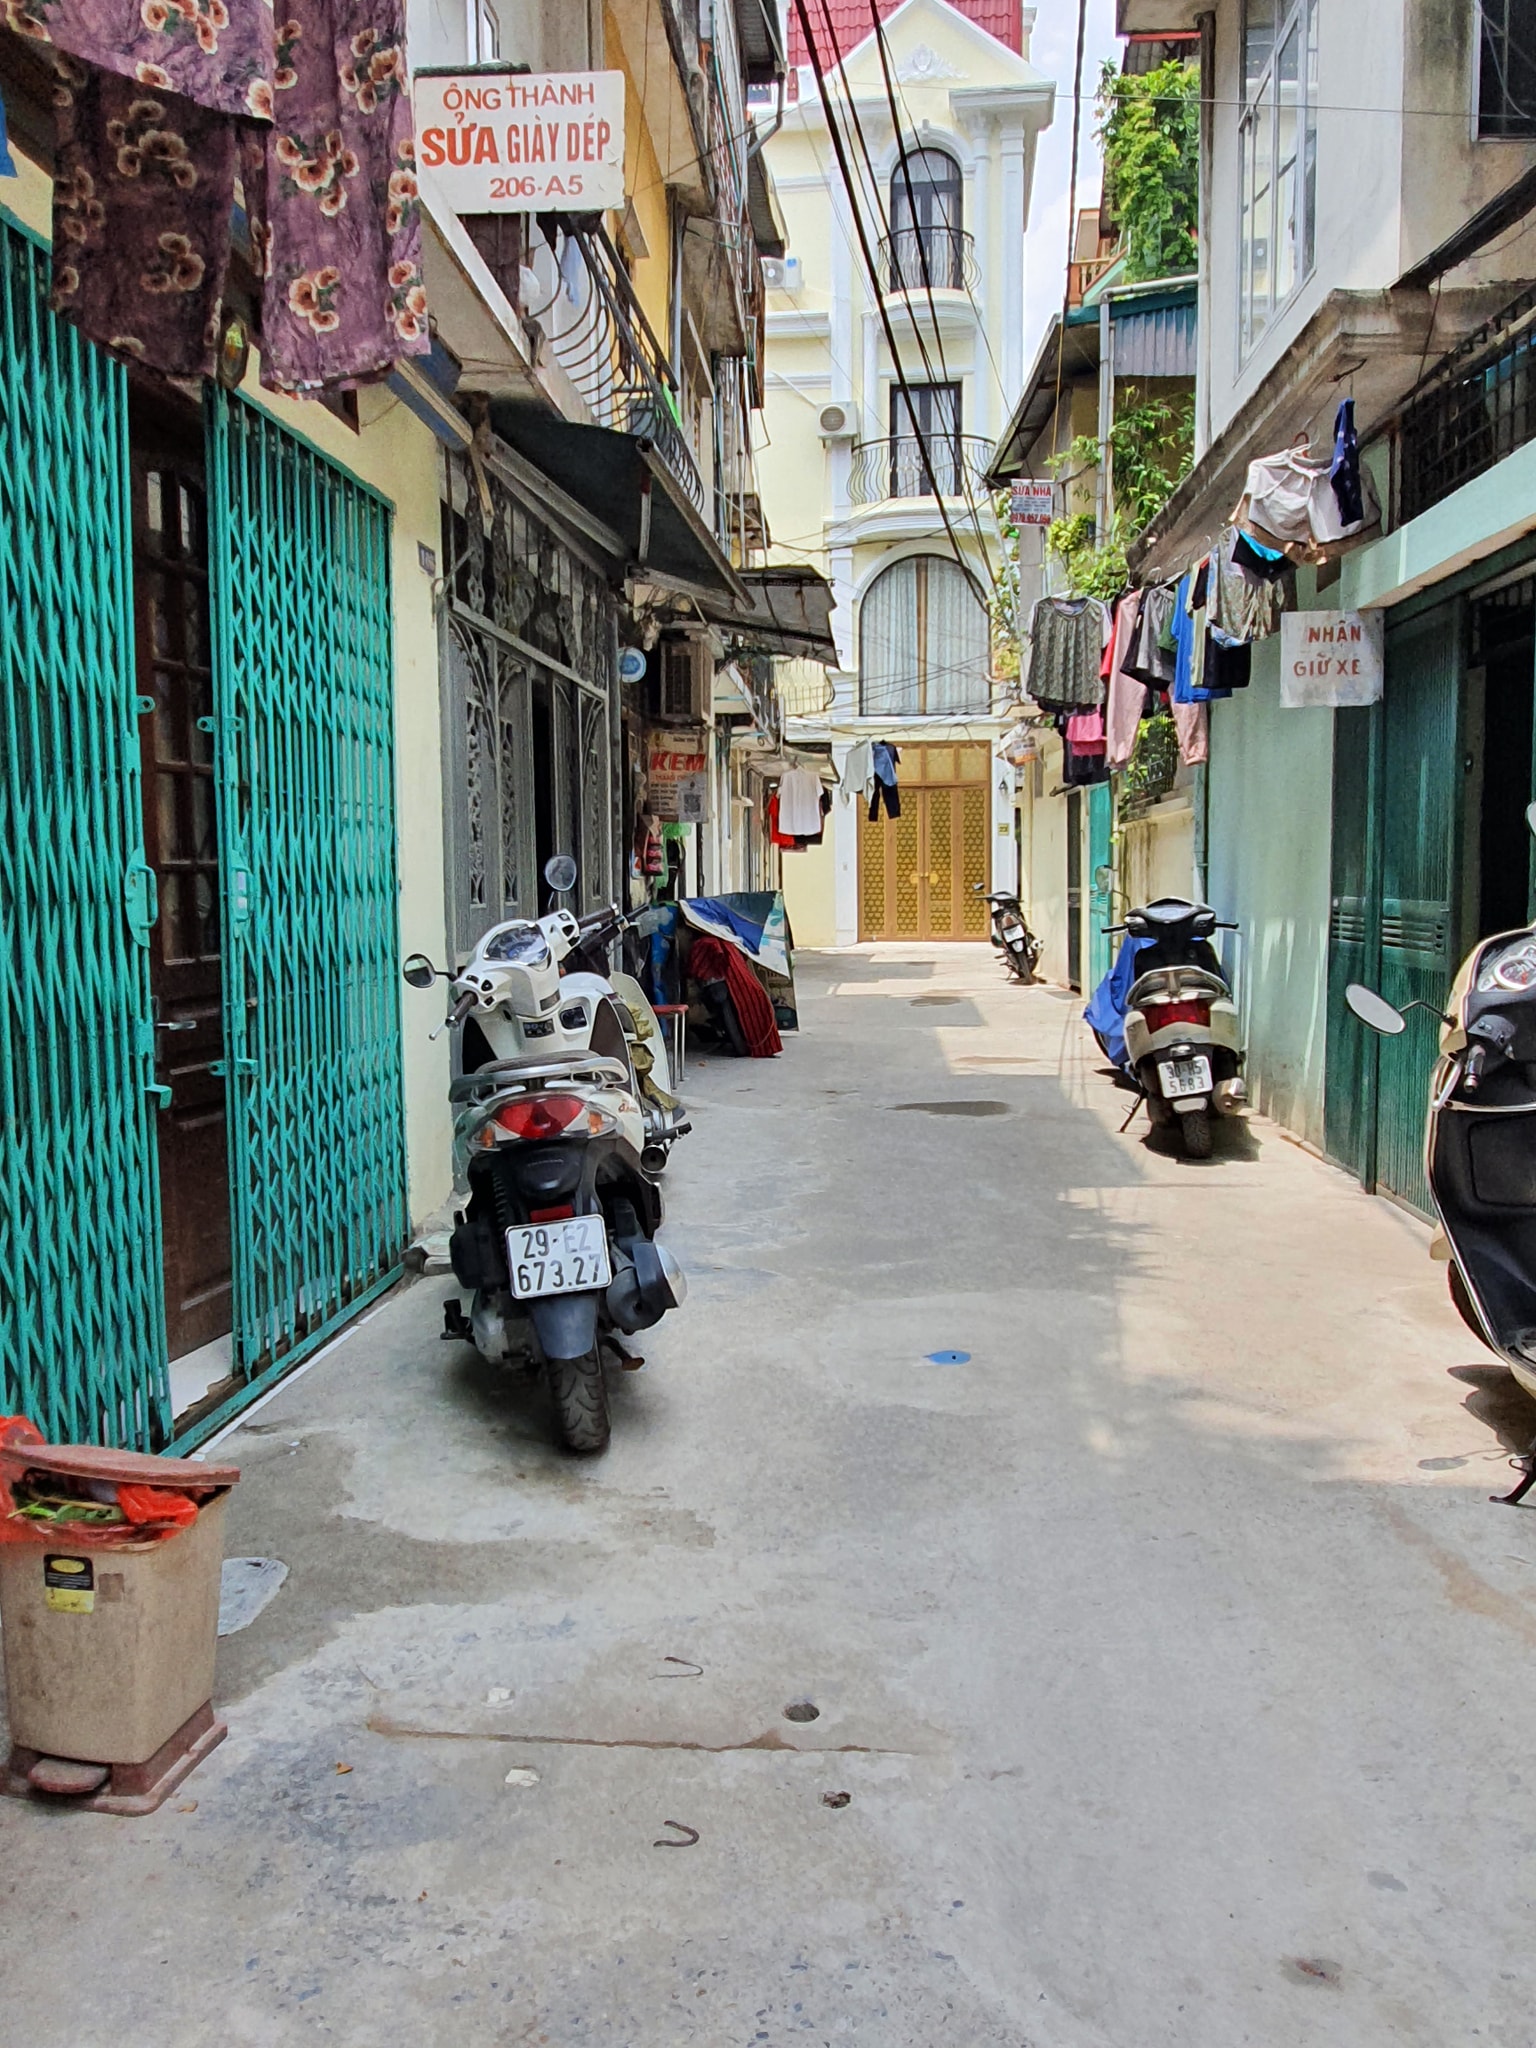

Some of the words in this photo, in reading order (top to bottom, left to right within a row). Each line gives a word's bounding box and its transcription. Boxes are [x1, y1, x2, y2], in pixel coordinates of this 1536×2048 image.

[442, 82, 502, 111] ÔNG
[505, 78, 595, 109] THÀNH
[420, 111, 500, 167] SỬA
[506, 114, 560, 164] GIÀY
[566, 112, 612, 163] DÉP
[1293, 651, 1333, 678] GIỮ
[1336, 658, 1361, 677] XE
[651, 752, 707, 772] KEM
[516, 1253, 601, 1293] 673.27
